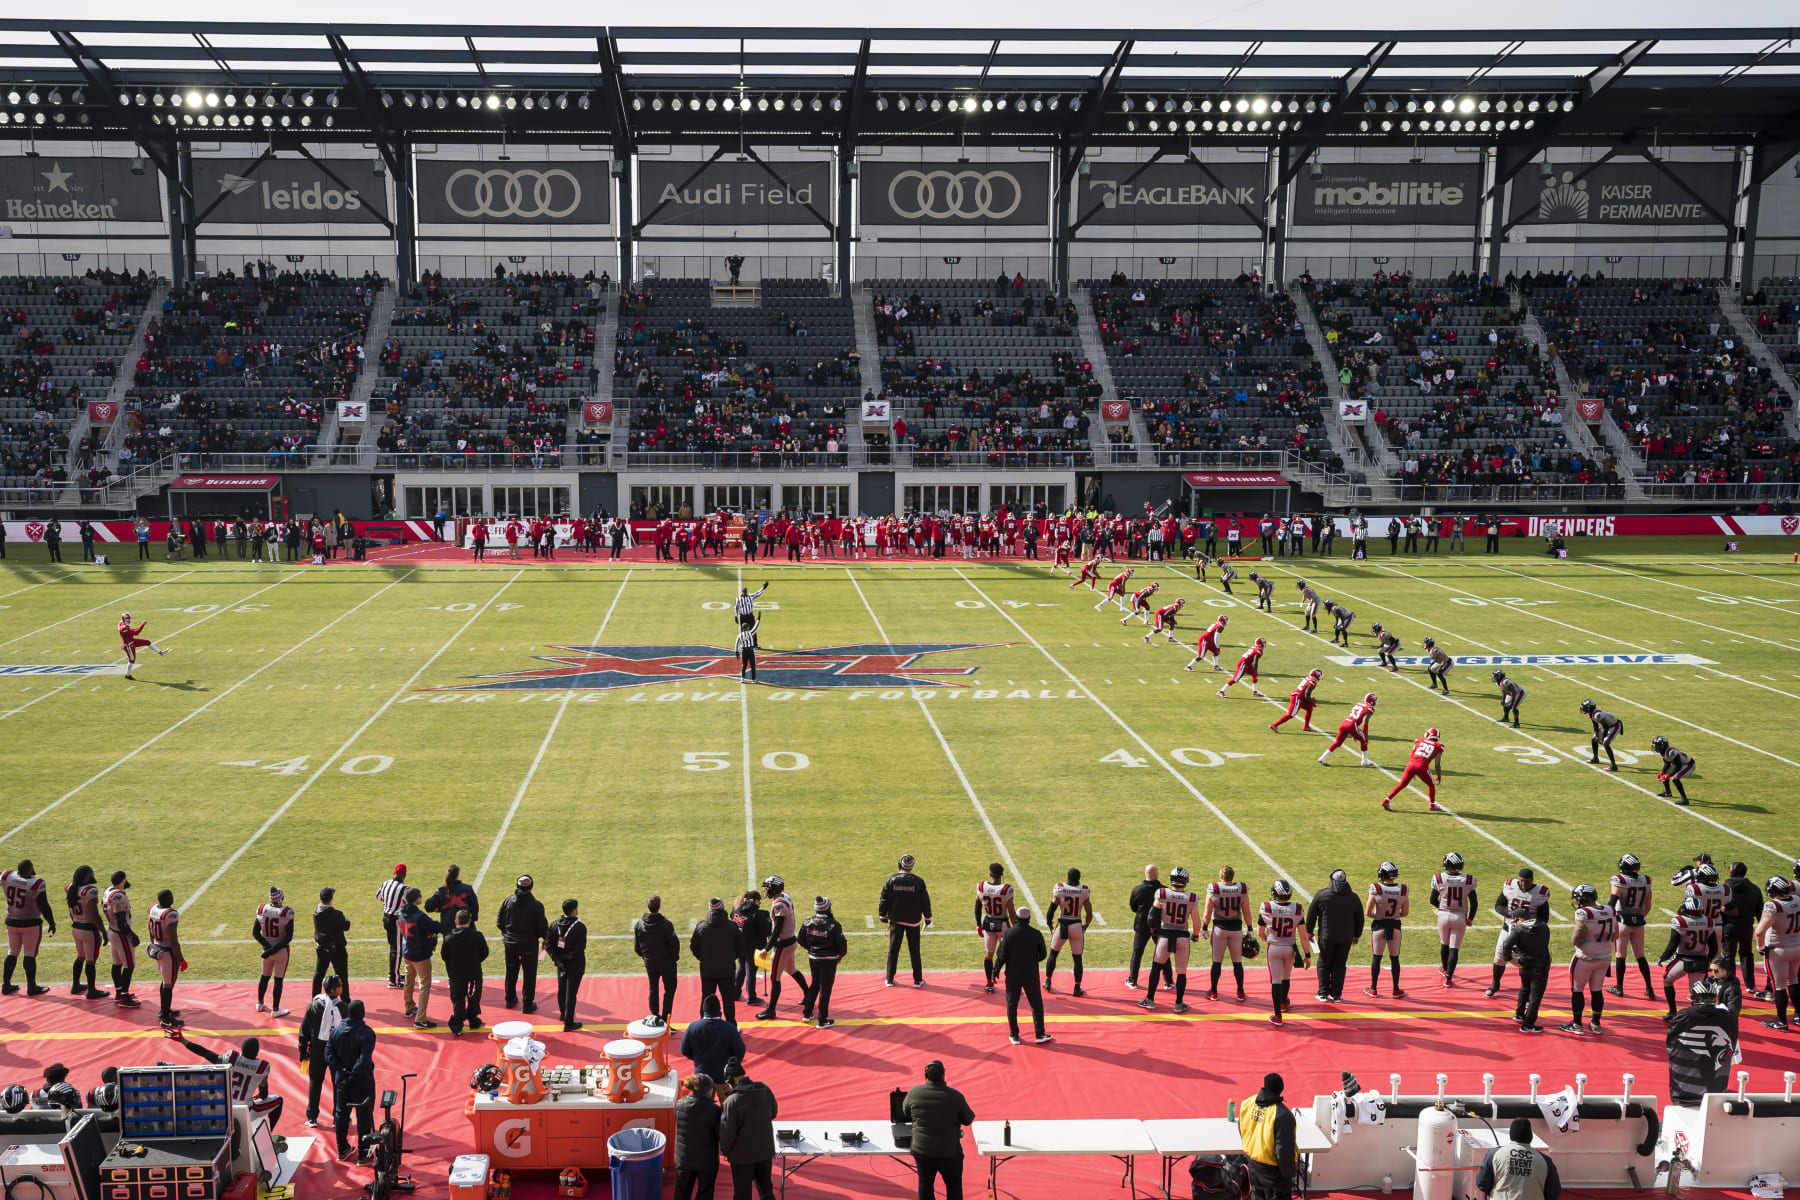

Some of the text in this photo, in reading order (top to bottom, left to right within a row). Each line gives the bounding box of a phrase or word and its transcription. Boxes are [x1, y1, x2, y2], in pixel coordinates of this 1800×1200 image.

[262, 180, 361, 210] leidos
[658, 183, 812, 205] Audi Field
[1314, 182, 1464, 206] mobilitie
[1602, 185, 1652, 199] KAISER
[1314, 207, 1397, 216] intelligent infrastructure
[312, 555, 322, 564] 30
[1351, 653, 1680, 666] PROGRESSIVE
[398, 689, 1087, 703] FOR THE LOVE OF FOOTBALL
[681, 751, 811, 772] 50
[1099, 747, 1226, 768] 40
[1414, 742, 1436, 759] 29
[7, 885, 27, 909] 95
[982, 895, 1003, 917] 36
[1063, 895, 1081, 918] 31
[1219, 895, 1242, 918] 44
[1384, 897, 1398, 918] 3
[1446, 886, 1464, 908] 14
[1625, 886, 1647, 908] 87
[1165, 901, 1188, 925] 49
[1704, 898, 1722, 919] 12
[264, 915, 280, 938] 16
[1271, 916, 1295, 939] 42
[1595, 917, 1613, 943] 77
[1685, 929, 1709, 951] 34
[514, 1065, 530, 1082] G
[617, 1064, 632, 1081] G
[231, 1071, 252, 1102] 21
[493, 1117, 532, 1158] G
[1509, 1159, 1533, 1169] EVENT
[1510, 1148, 1533, 1160] CSC
[1508, 1168, 1533, 1177] STAFF
